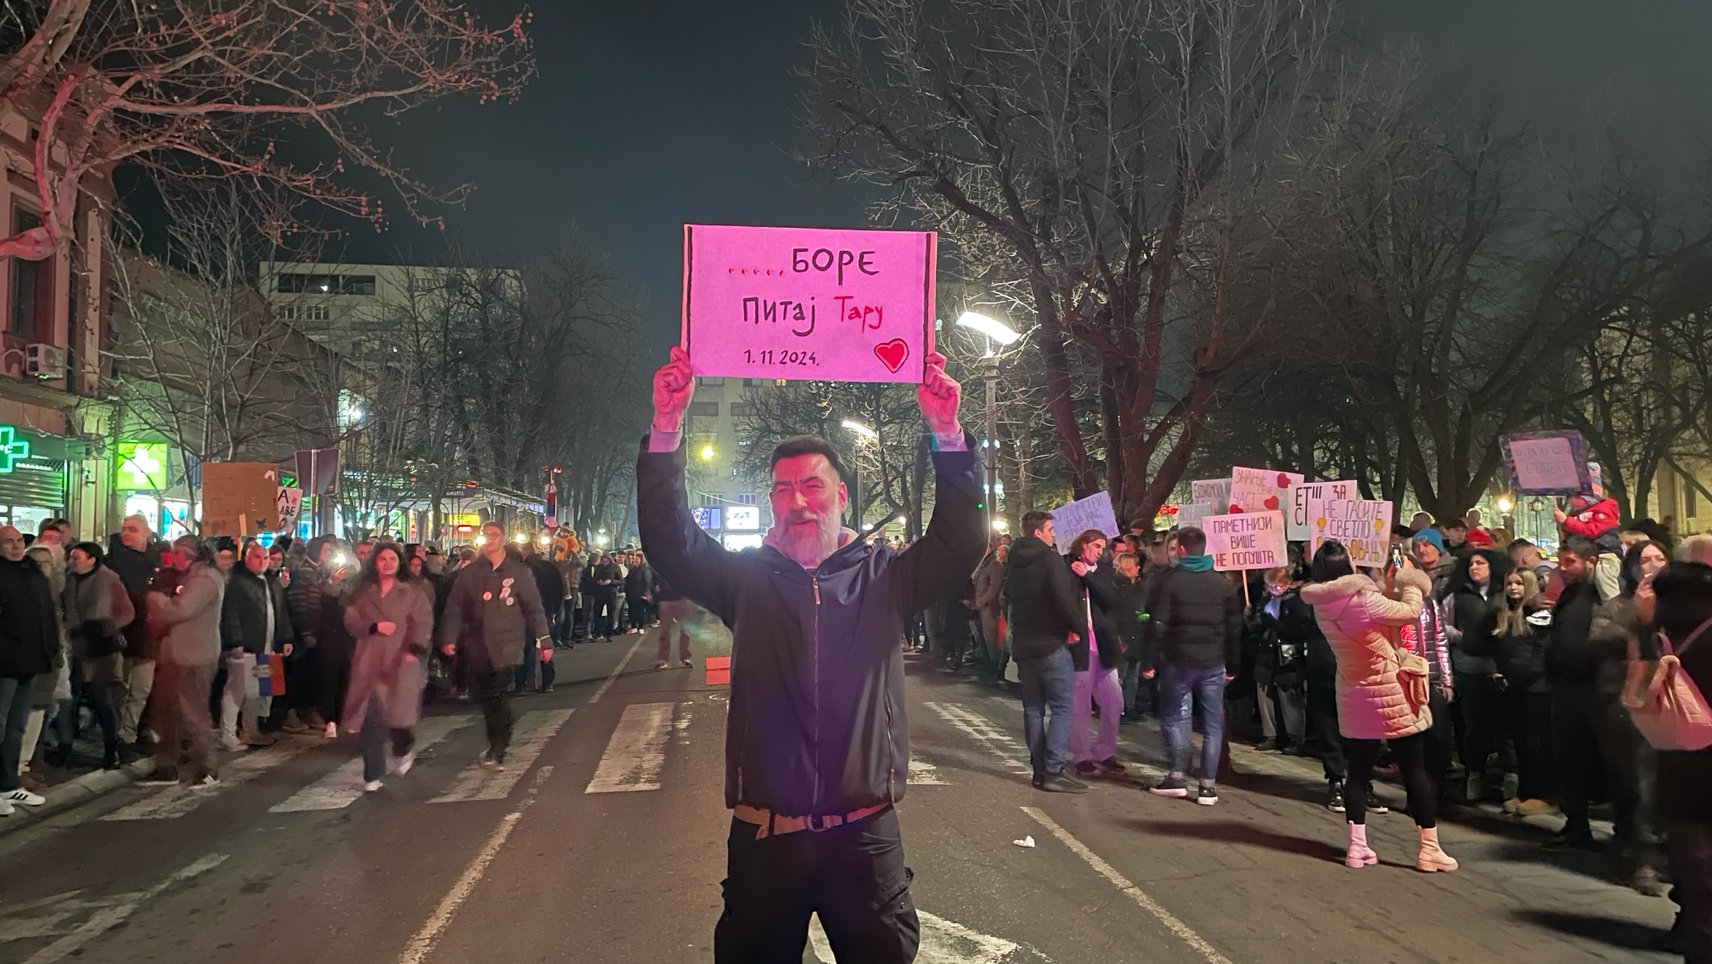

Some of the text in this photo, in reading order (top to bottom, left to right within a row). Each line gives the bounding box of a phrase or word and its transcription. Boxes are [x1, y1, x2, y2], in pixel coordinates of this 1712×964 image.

[742, 296, 883, 337] Питај Тару
[1323, 499, 1338, 519] НЕ
[1213, 516, 1273, 533] ПАМЕТНИЈИ
[1329, 519, 1371, 539] СВЕТЛО
[1230, 534, 1256, 550] ВИШЕ
[1215, 550, 1274, 567] НЕ ПОПУШТА
